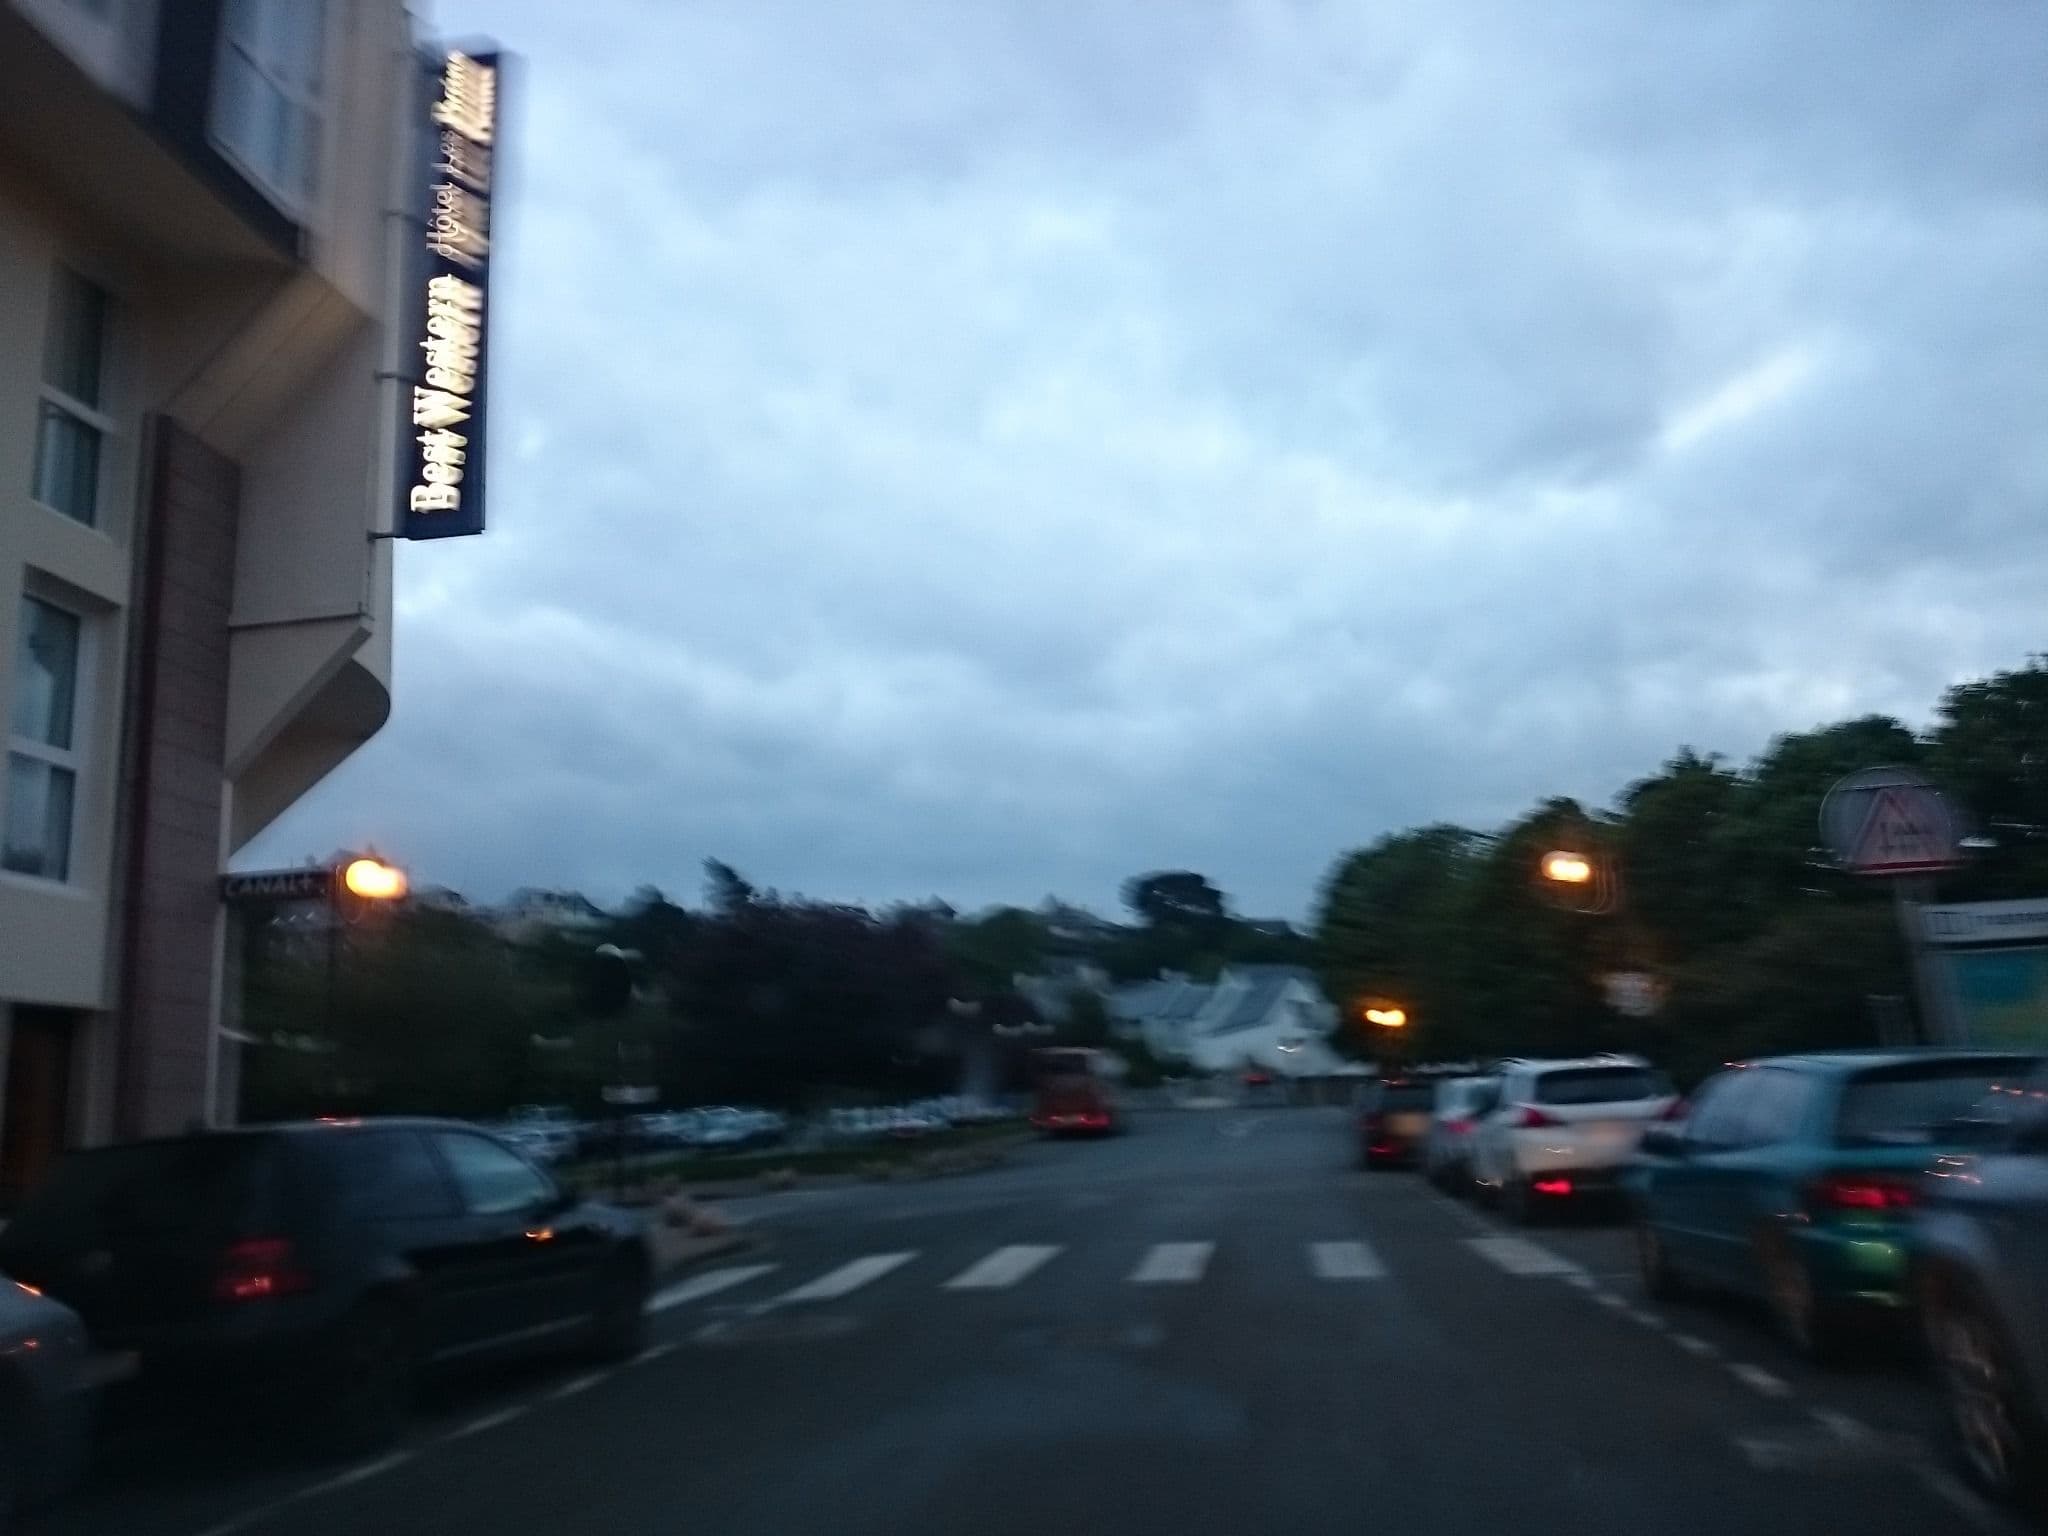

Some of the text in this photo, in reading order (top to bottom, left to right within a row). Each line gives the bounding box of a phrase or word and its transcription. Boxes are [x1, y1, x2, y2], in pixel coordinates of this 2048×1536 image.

[426, 182, 472, 257] Hôtel
[414, 274, 473, 430] Western
[411, 428, 462, 513] Best
